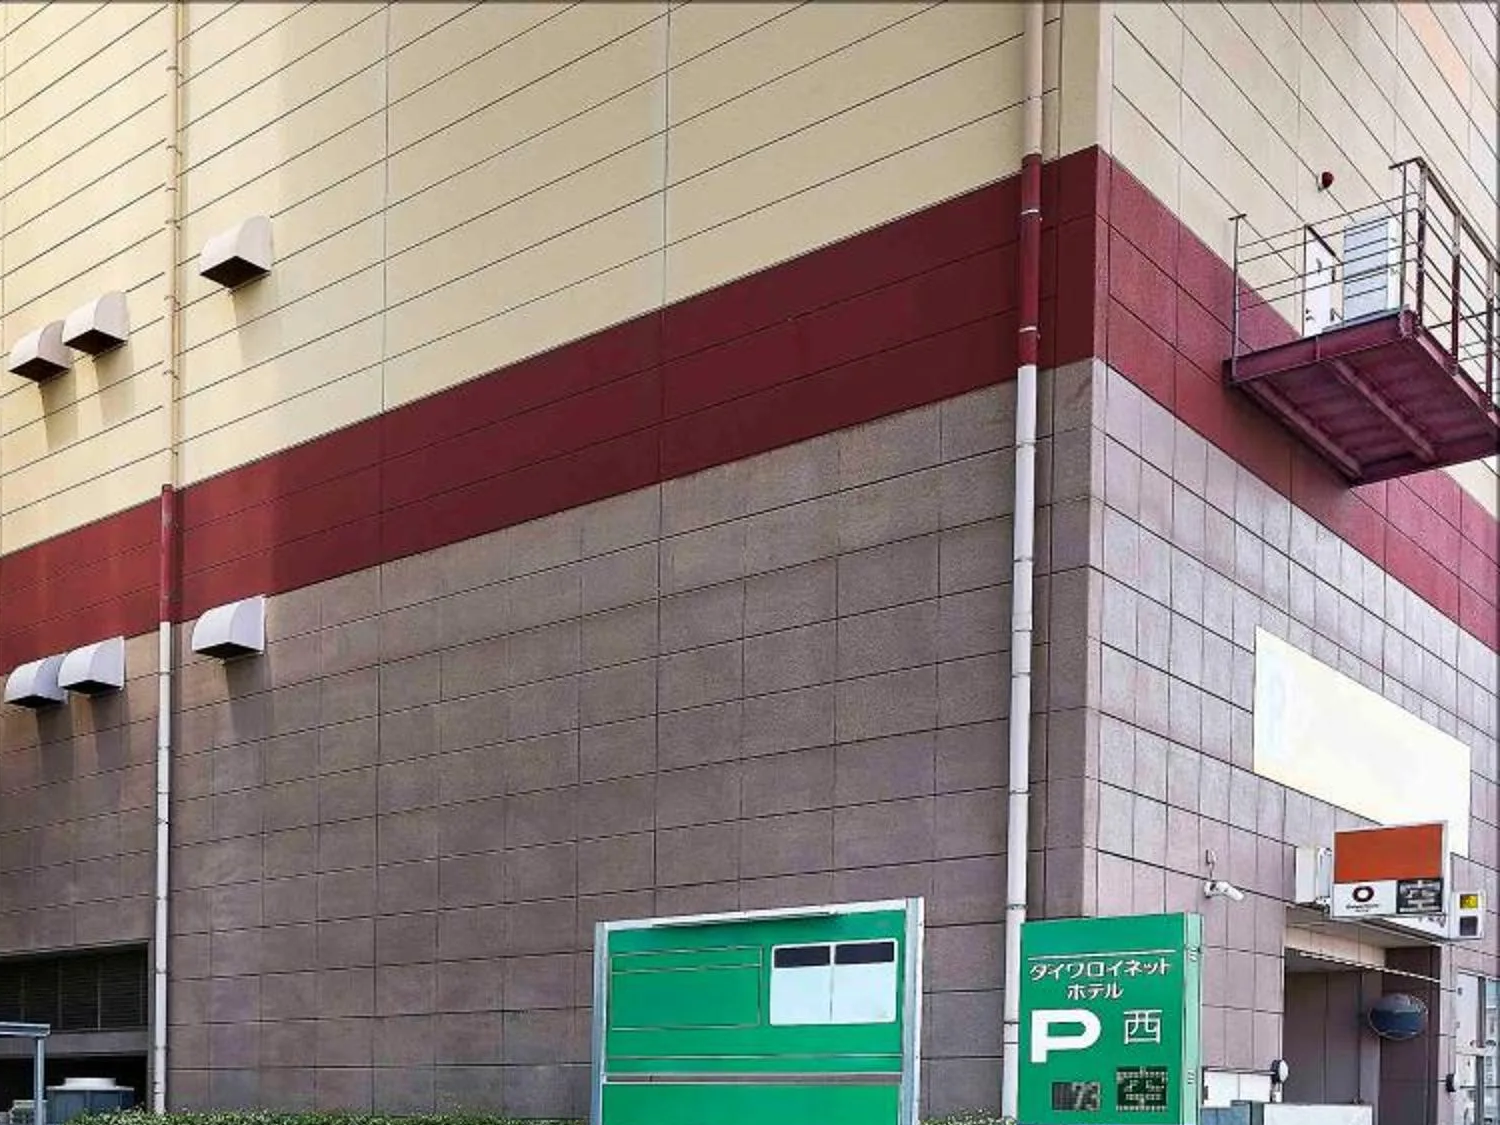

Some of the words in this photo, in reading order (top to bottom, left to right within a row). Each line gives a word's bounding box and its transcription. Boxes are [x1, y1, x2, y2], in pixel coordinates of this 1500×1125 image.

[1067, 982, 1124, 1000] ホテル
[1030, 1009, 1101, 1063] P
[1123, 1009, 1162, 1044] 西
